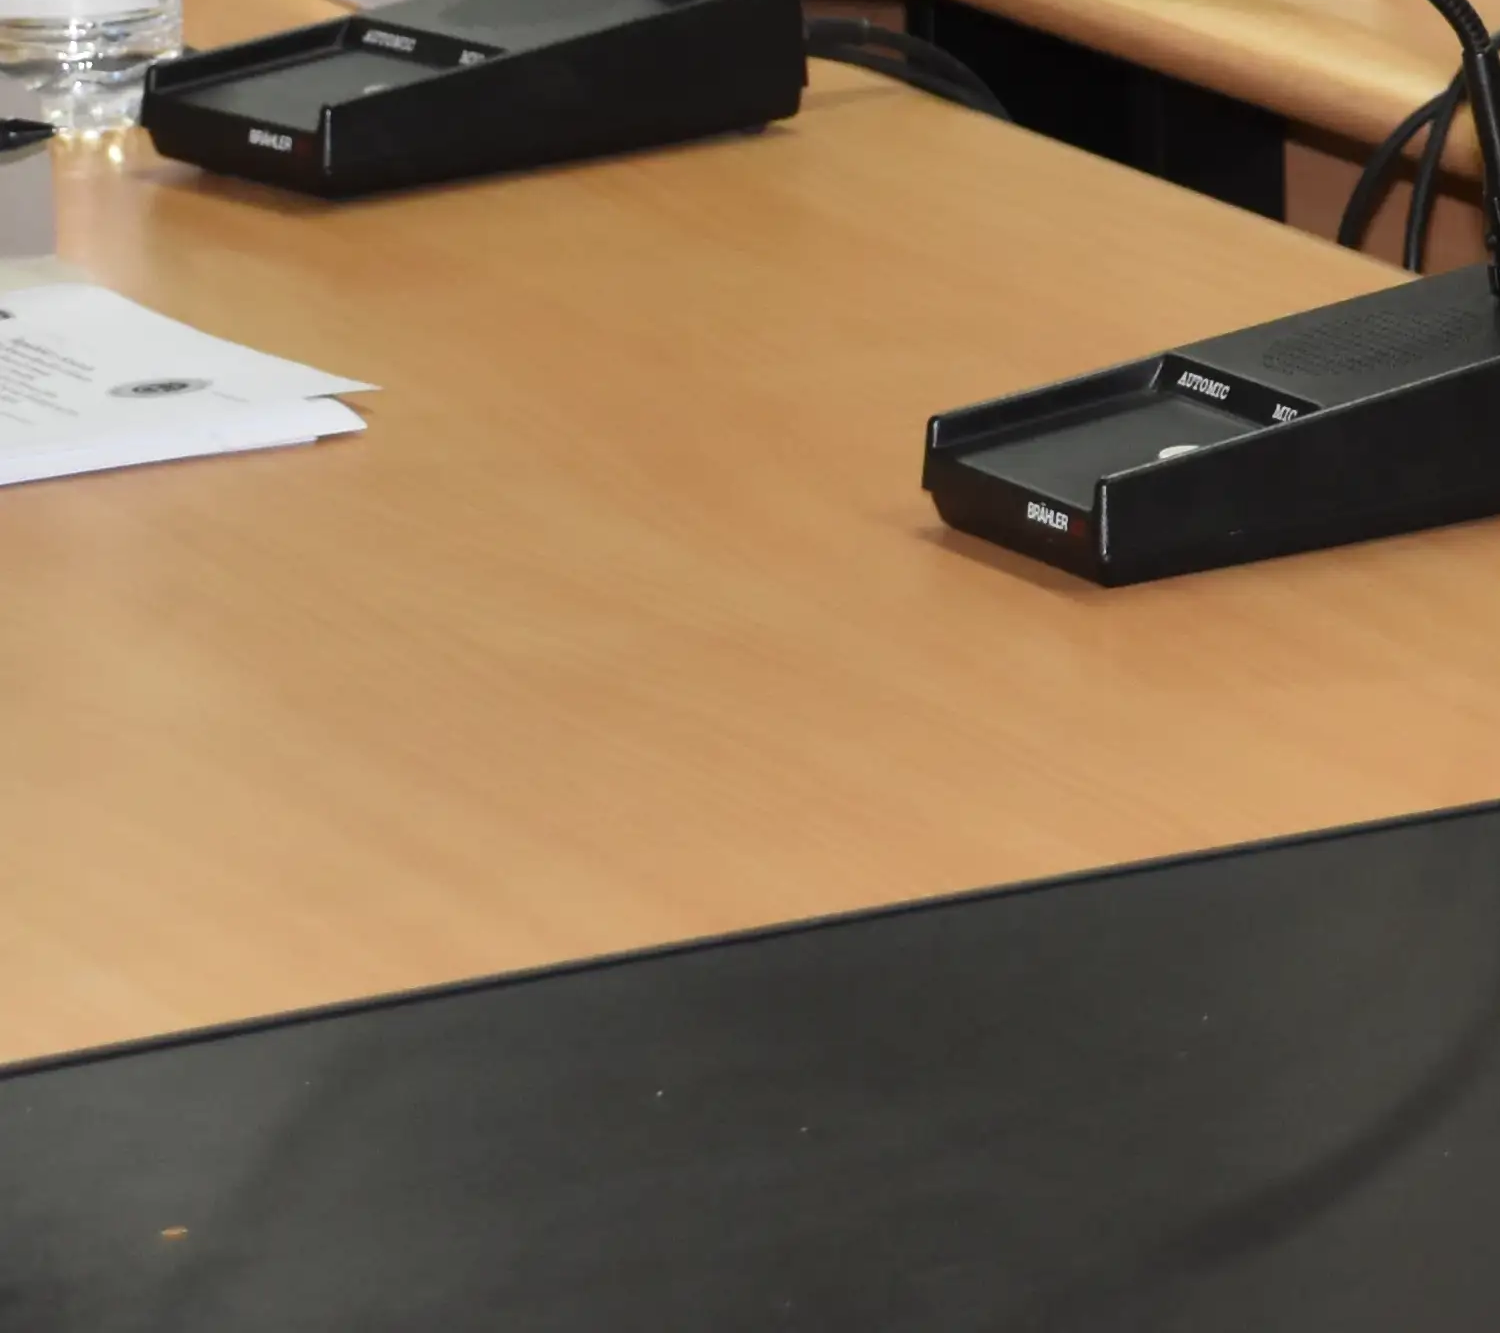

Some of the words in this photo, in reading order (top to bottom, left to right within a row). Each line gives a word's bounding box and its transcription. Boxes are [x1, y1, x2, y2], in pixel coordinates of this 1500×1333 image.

[1177, 370, 1231, 401] AUTOMIC
[1271, 403, 1299, 423] MIC
[1026, 500, 1069, 533] BRÄHLER
